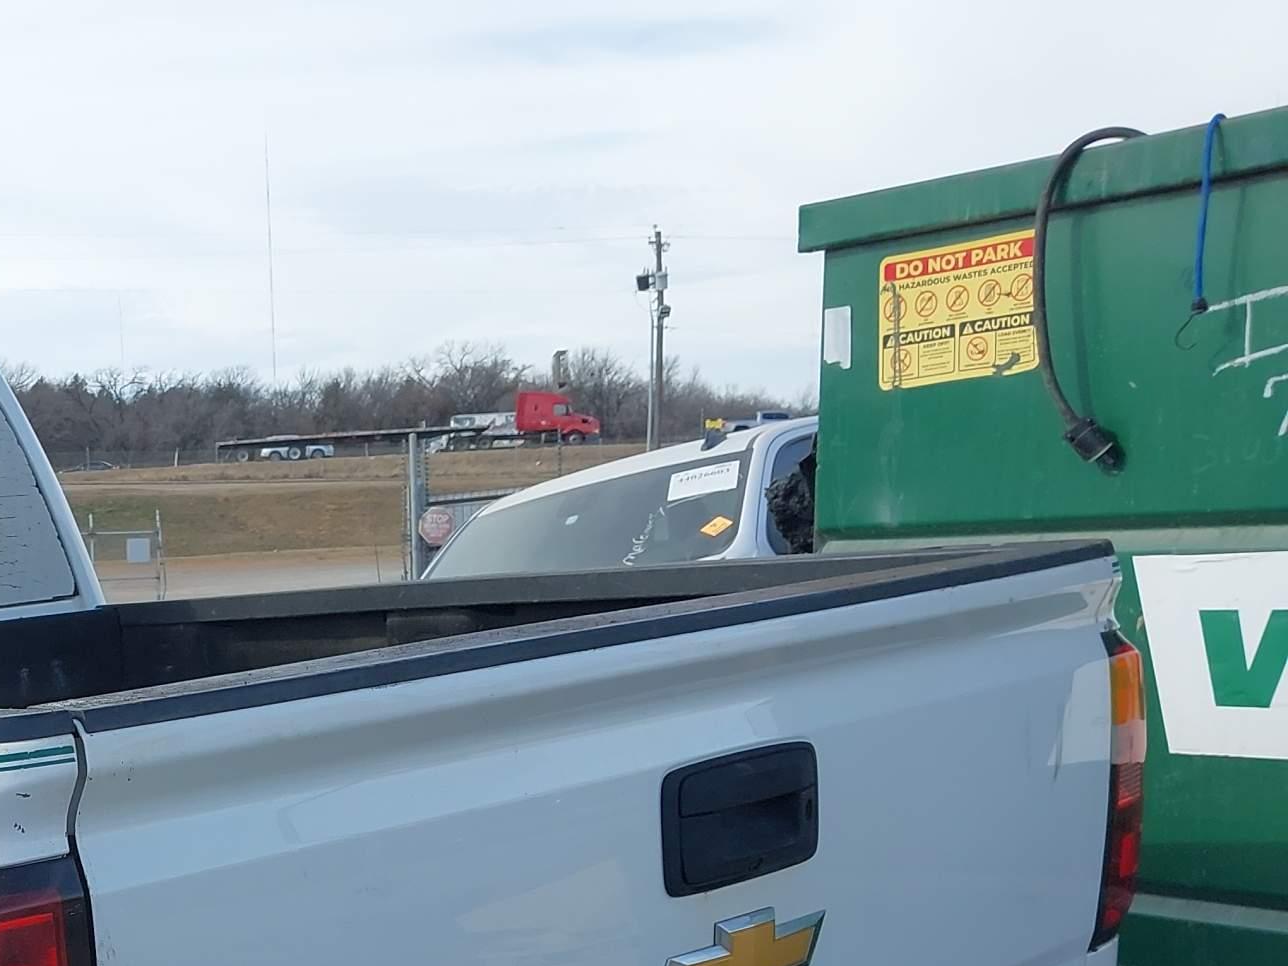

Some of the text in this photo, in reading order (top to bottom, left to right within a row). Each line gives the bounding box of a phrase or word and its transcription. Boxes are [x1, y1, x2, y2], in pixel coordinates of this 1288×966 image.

[895, 241, 1024, 279] DO NOT PARK
[899, 276, 951, 291] HAZARDOUS
[953, 269, 988, 281] WASTES
[974, 314, 1030, 331] CAUTION
[898, 326, 951, 344] CAUTION
[425, 513, 450, 524] STOP
